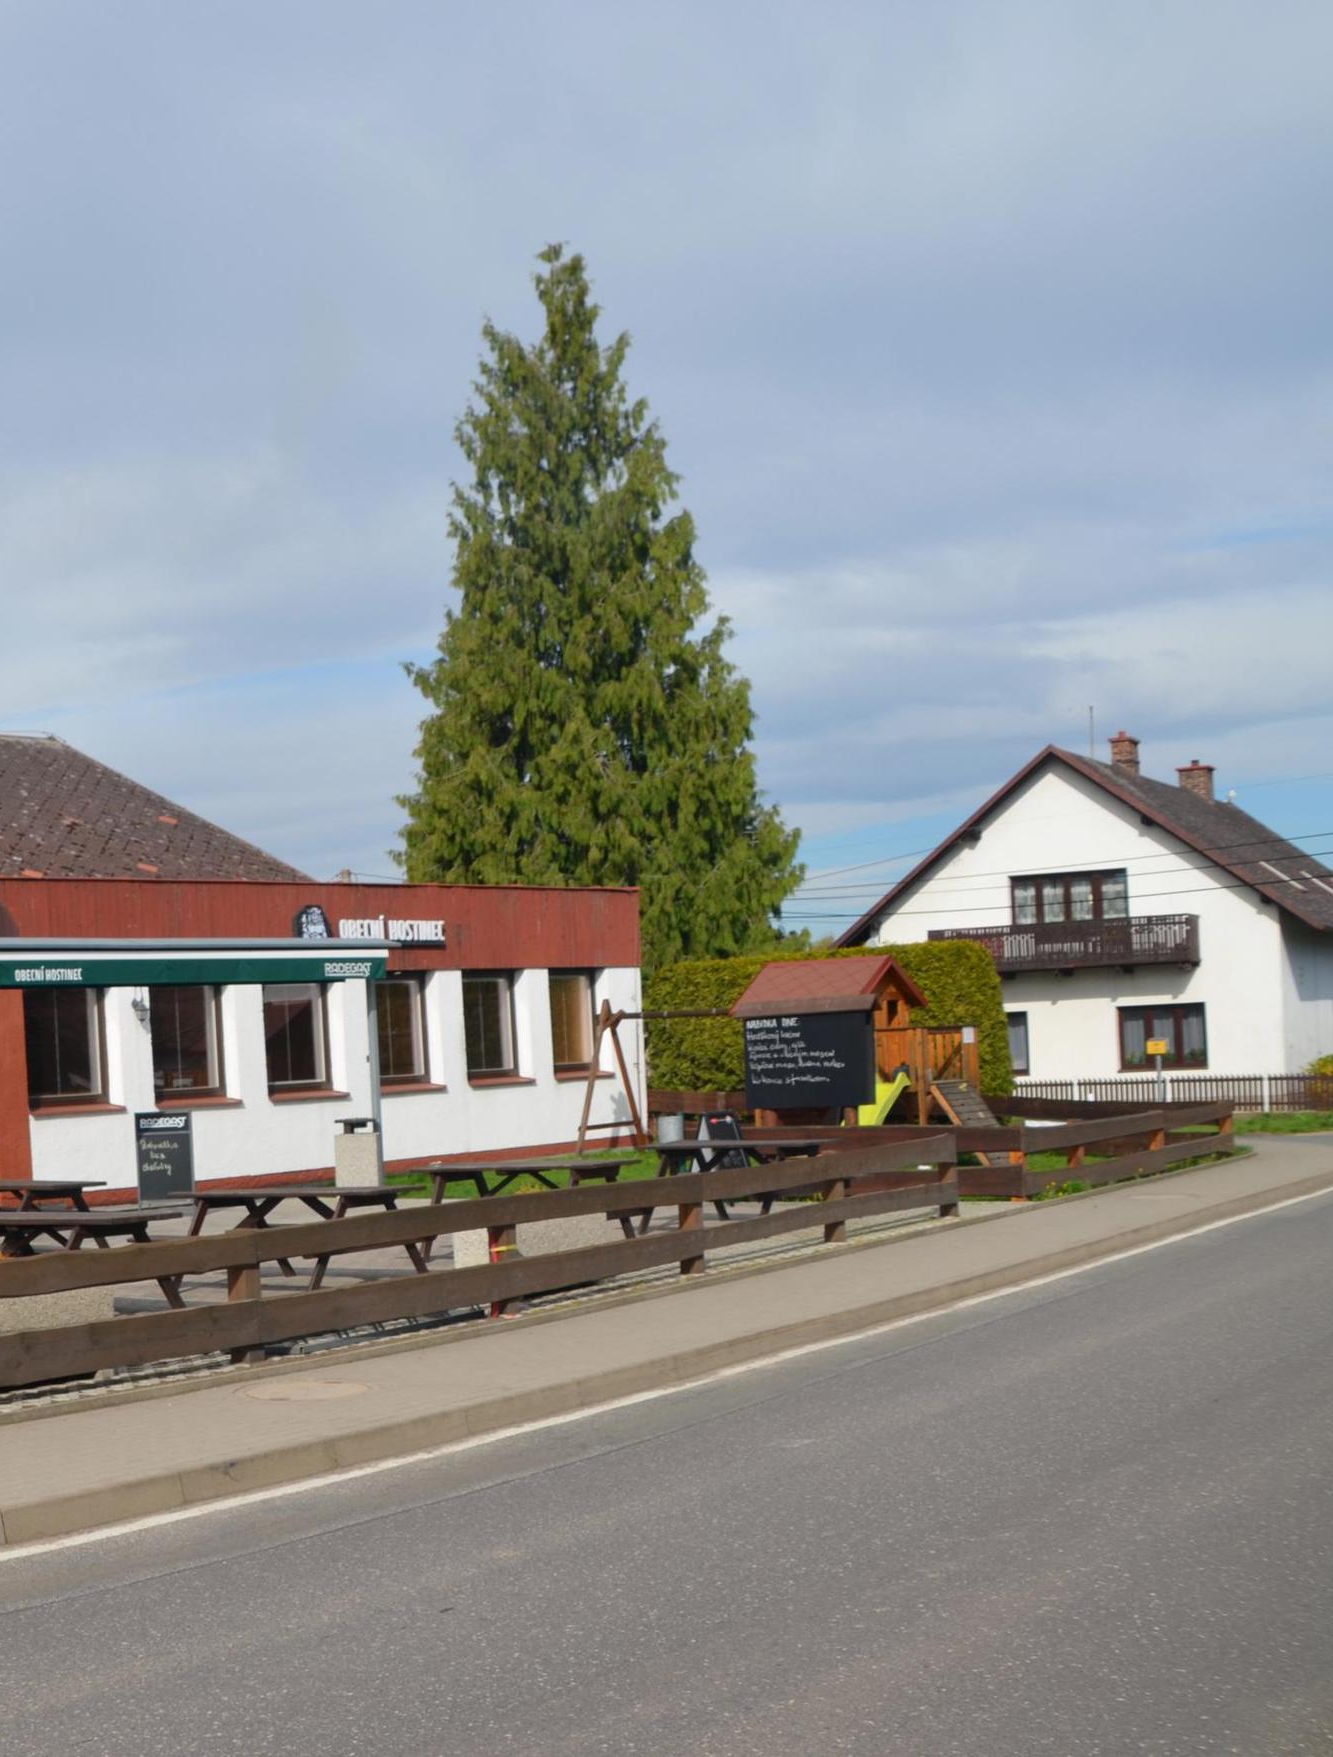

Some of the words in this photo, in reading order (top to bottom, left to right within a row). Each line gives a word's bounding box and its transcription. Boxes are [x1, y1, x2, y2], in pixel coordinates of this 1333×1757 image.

[339, 915, 384, 938] OBECNÍ
[388, 920, 445, 940] HOSTINEC
[15, 965, 44, 981] OBECNÍ
[45, 968, 83, 981] HOSTINEC
[325, 963, 372, 977] RADEGAST
